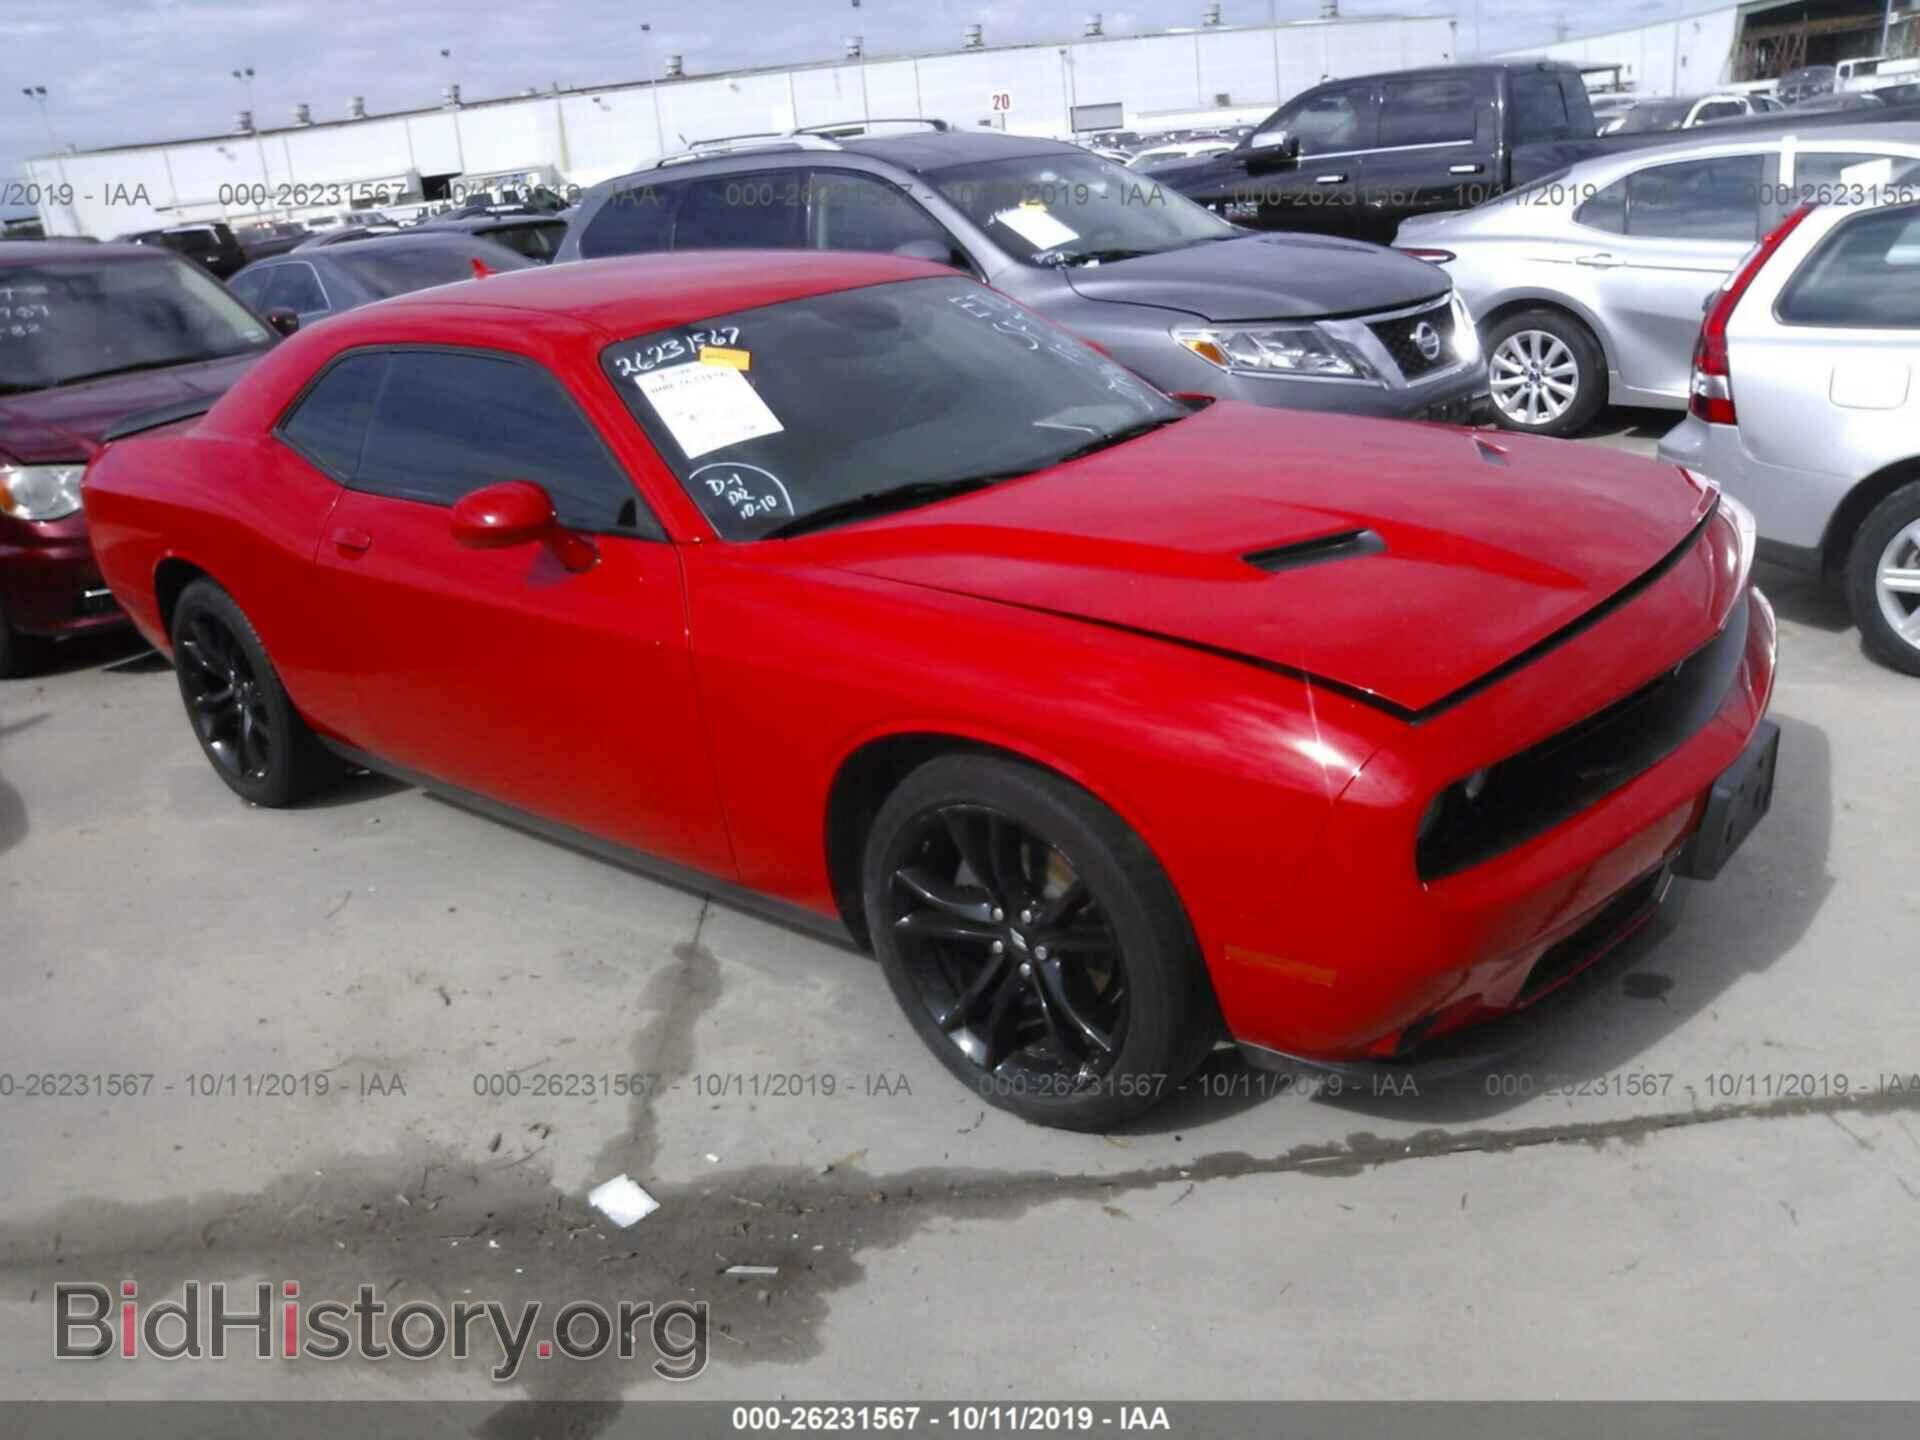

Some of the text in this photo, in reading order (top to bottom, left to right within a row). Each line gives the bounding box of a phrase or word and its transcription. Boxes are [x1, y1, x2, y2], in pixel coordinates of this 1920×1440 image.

[993, 94, 1010, 110] 20
[615, 326, 740, 377] 26231567
[740, 494, 777, 520] 10-10
